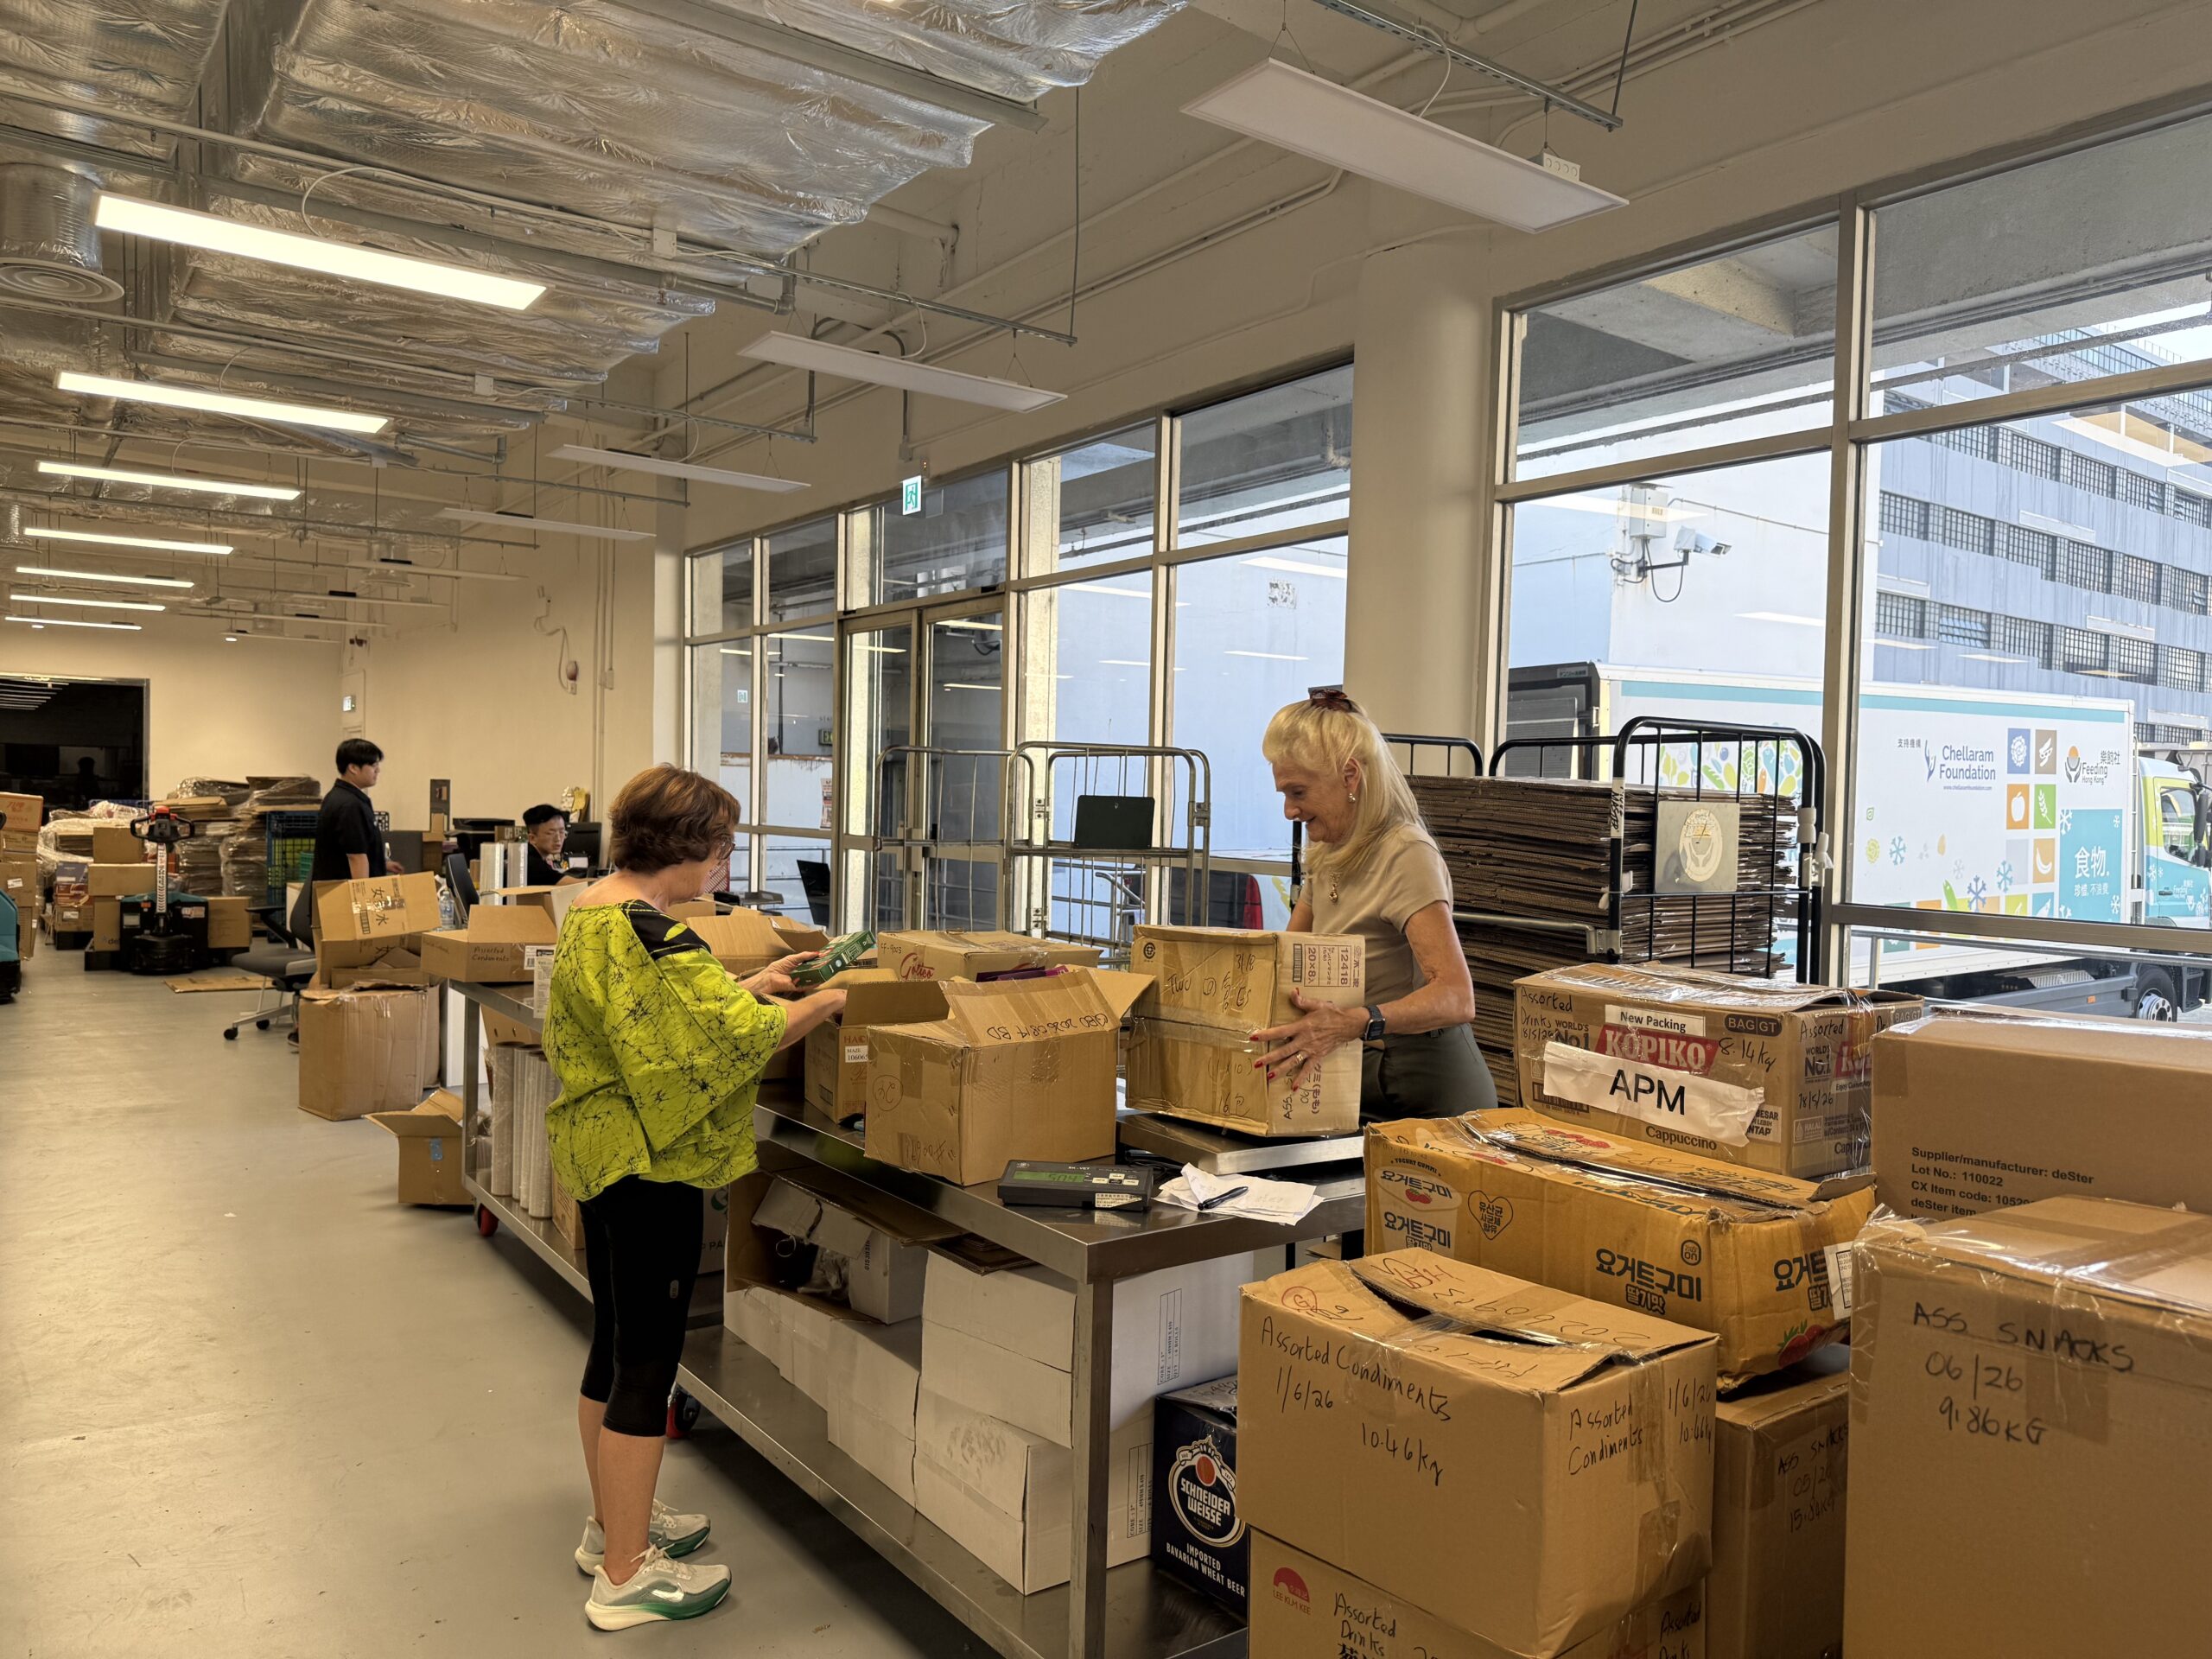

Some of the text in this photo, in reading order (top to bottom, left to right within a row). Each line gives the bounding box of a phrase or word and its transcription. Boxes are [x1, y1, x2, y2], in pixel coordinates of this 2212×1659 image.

[823, 731, 832, 743] EX
[1942, 745, 1994, 762] Chellaram
[1939, 764, 1996, 780] Foundation
[2082, 762, 2108, 778] Feeding
[1340, 947, 1349, 985] 12418
[1521, 986, 1573, 1013] Assorted
[1521, 1006, 1551, 1028] Drinks
[1555, 1020, 1589, 1032] WORLD'S
[1620, 1011, 1687, 1033] New Packing
[1728, 1017, 1777, 1033] BAG GT
[1800, 1019, 1844, 1042] Assorted
[1605, 1029, 1706, 1069] KOPIKO
[1609, 1069, 1686, 1116] APM
[1645, 1126, 1718, 1151] Cappuccino
[1910, 1163, 2004, 1187] Lot No.: 110022
[1911, 1147, 2094, 1185] Supplier/manufacturer: deSter
[1381, 1170, 1452, 1199] 요거트구미
[1910, 1180, 1928, 1192] CX
[1930, 1185, 1955, 1197] Item
[1959, 1187, 1992, 1203] code:
[1478, 1201, 1503, 1217] 유산균
[1910, 1197, 1977, 1216] deSter item
[1383, 1211, 1451, 1249] 요거트구미
[1596, 1248, 1702, 1302] 요거트구미
[1625, 1283, 1666, 1315] 딸기맛
[1913, 1300, 2135, 1372] ASS SNACKS
[1262, 1316, 1330, 1365] Assorted
[1336, 1344, 1452, 1421] Condiments
[1925, 1351, 2024, 1401] 06/26
[1276, 1364, 1334, 1414] 1/6/26
[1569, 1392, 1633, 1441] Assorted
[1568, 1423, 1643, 1476] Condiments
[1180, 1477, 1231, 1516] SCHNEIDER
[1187, 1495, 1222, 1527] WEISSE
[1166, 1541, 1245, 1598] BAVARIAN WHEAT BEER
[1186, 1542, 1221, 1571] IMPORTED
[1273, 1589, 1312, 1616] LEE KUM KEE
[1333, 1592, 1396, 1638] Assorted
[1340, 1619, 1385, 1657] Drinks
